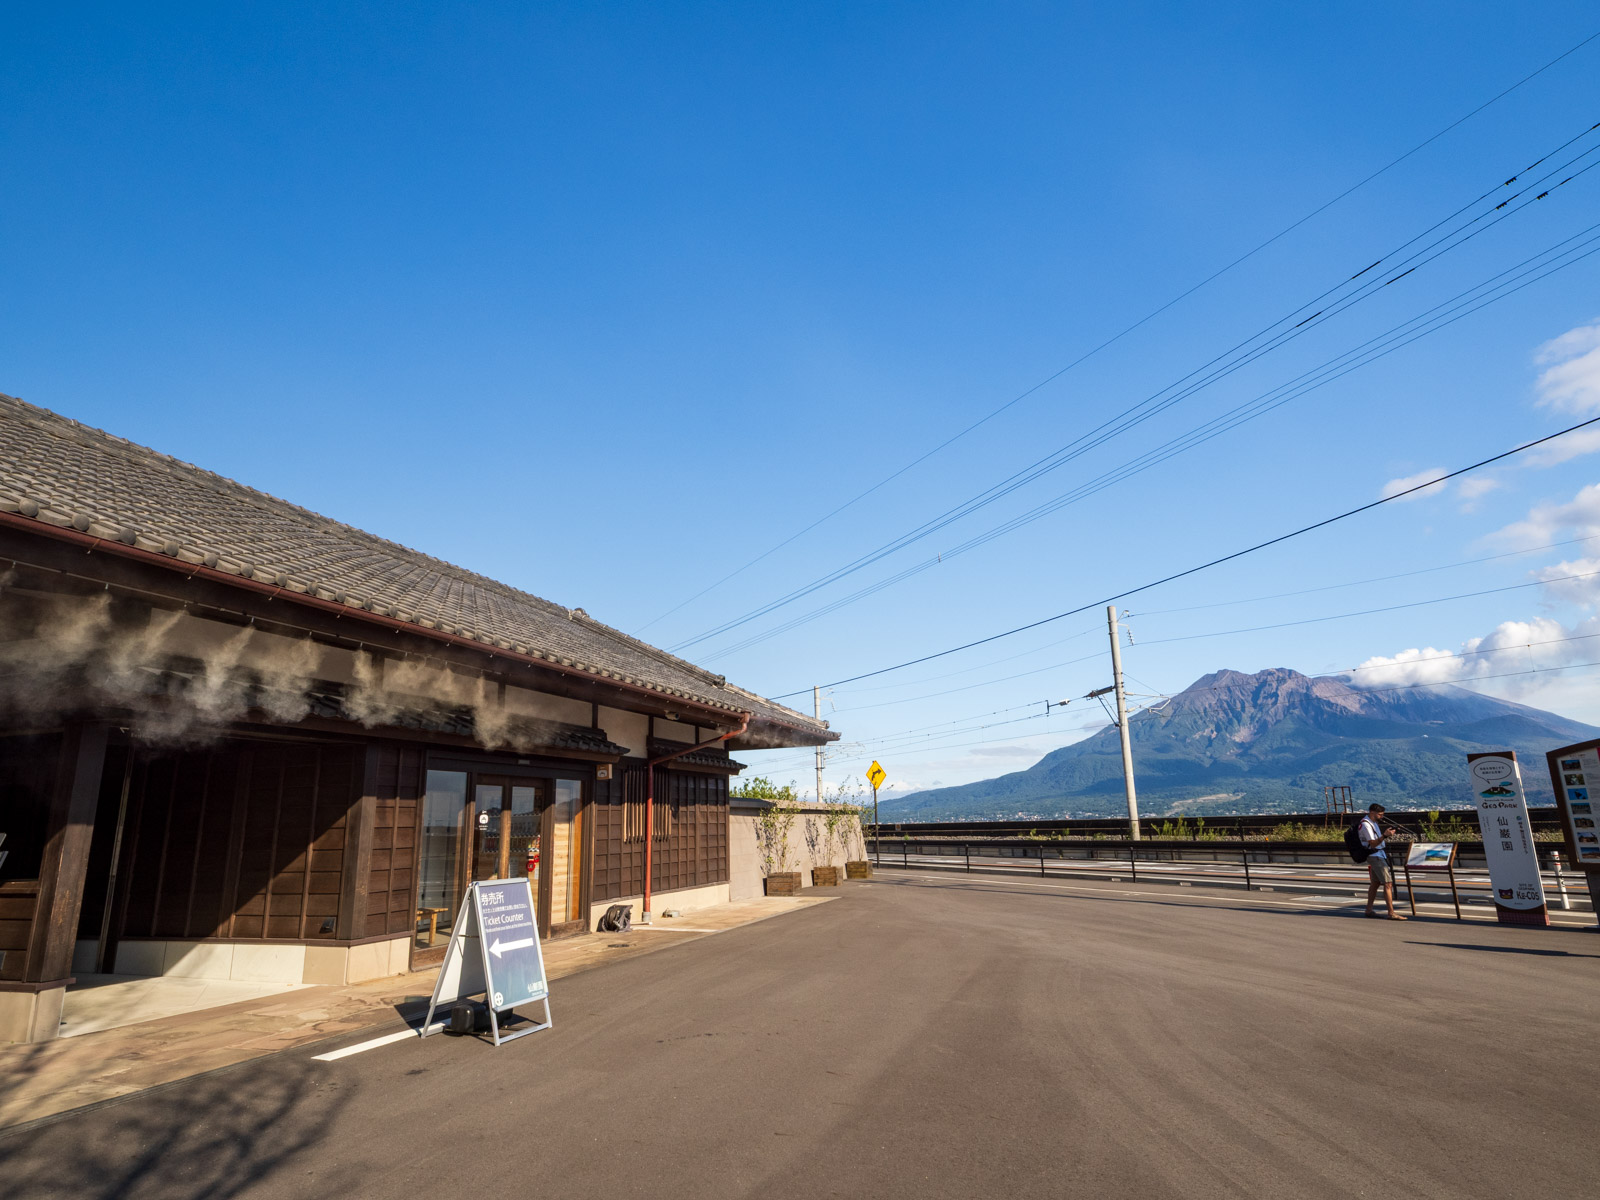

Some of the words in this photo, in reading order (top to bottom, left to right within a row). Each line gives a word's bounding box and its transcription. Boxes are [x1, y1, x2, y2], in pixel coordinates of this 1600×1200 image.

[481, 891, 504, 906] 券売所
[484, 916, 501, 926] Ticket
[501, 914, 524, 924] Counter
